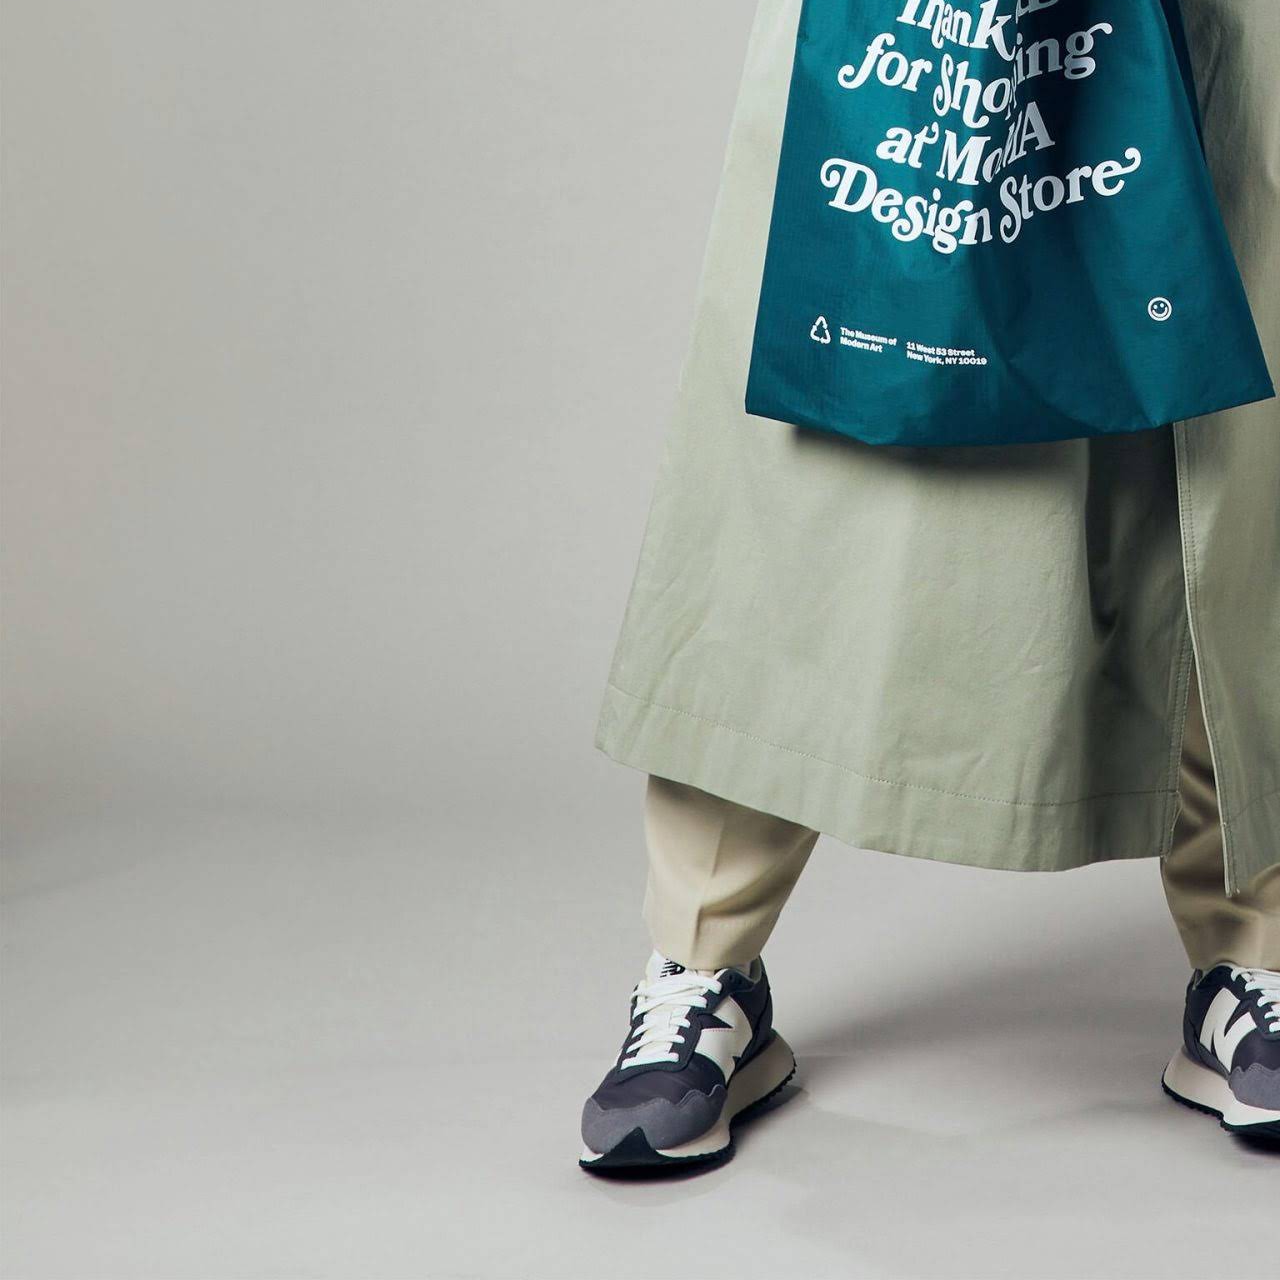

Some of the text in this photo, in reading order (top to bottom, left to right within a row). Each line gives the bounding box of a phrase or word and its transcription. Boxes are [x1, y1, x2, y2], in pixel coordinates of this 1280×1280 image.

[837, 32, 933, 93] for
[876, 121, 939, 169] at
[820, 147, 1142, 255] Design Store
[840, 326, 855, 338] The
[888, 337, 897, 346] of
[870, 342, 883, 353] Art
[906, 341, 975, 357] 11 West 53 Street
[906, 350, 923, 361] New
[945, 357, 957, 365] NY
[958, 357, 988, 366] 10019
